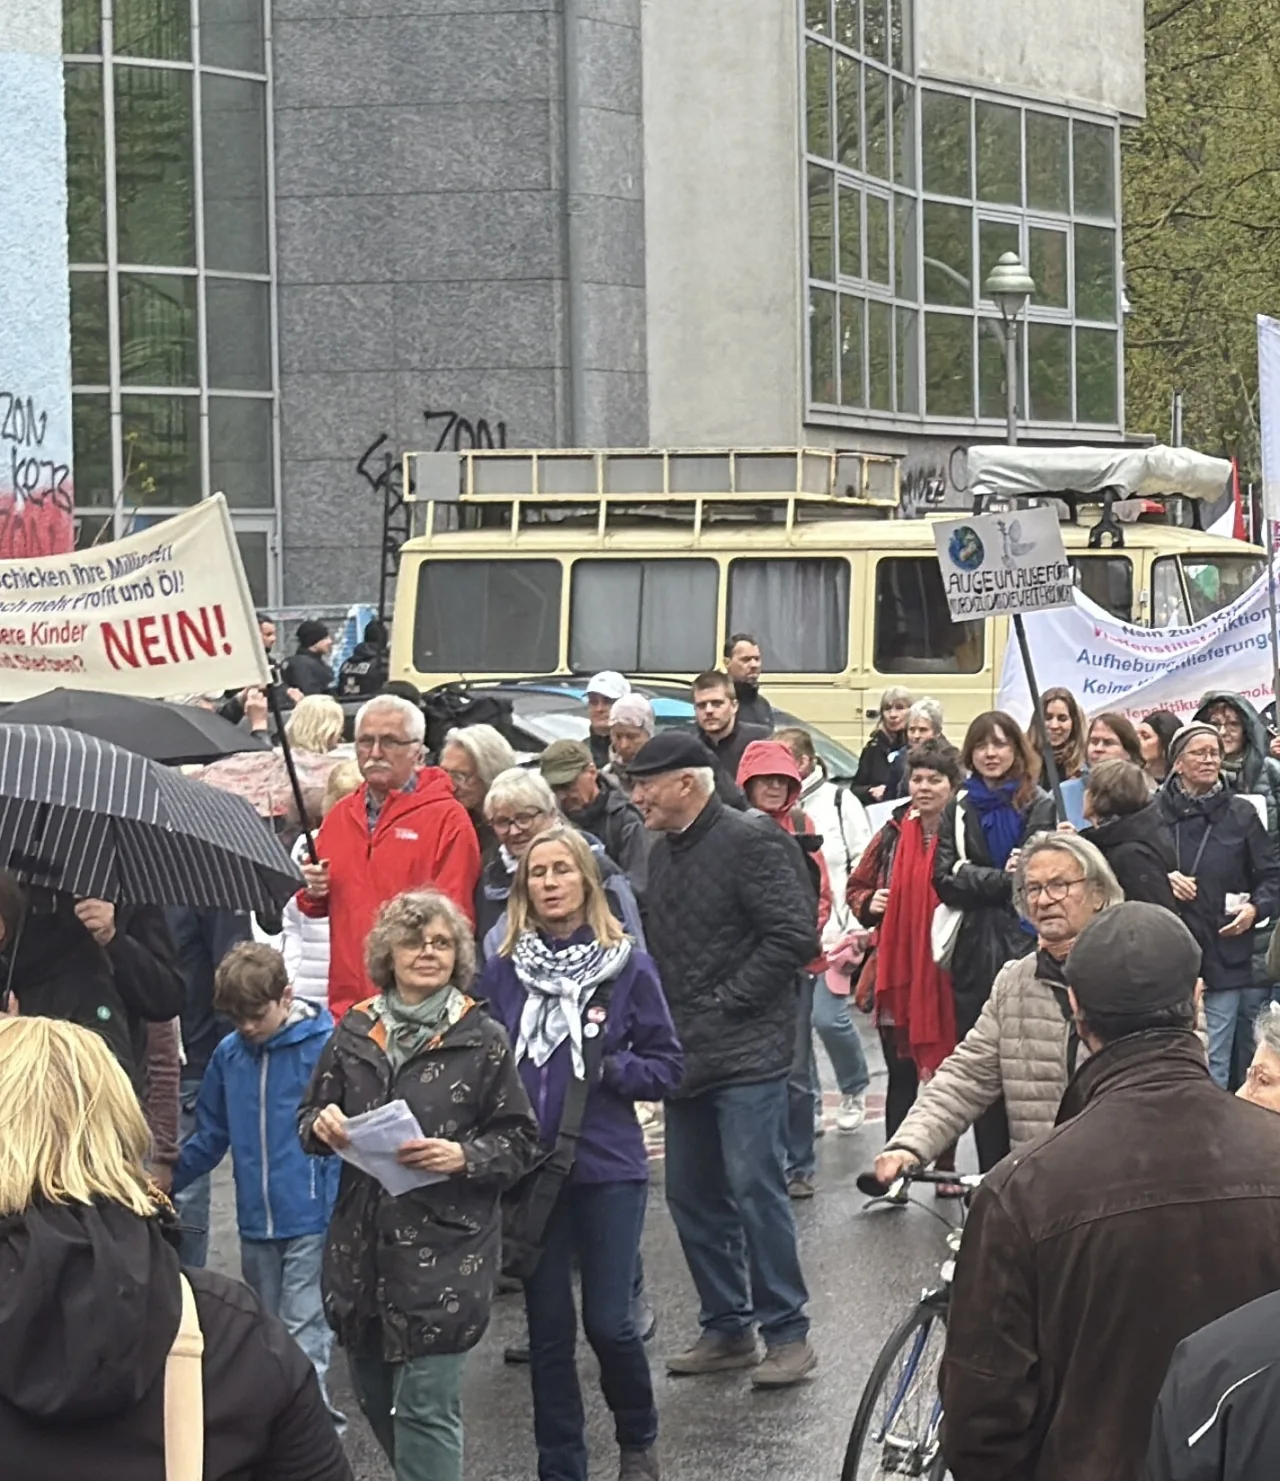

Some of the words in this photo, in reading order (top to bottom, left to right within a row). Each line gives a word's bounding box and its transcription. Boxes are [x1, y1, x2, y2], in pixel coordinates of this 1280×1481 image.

[119, 576, 154, 602] und
[157, 569, 185, 597] Öl!
[946, 571, 994, 594] AUGE
[994, 569, 1015, 590] UM
[31, 620, 88, 646] Kinder
[100, 604, 232, 670] NEIN!
[1083, 677, 1132, 694] Keine
